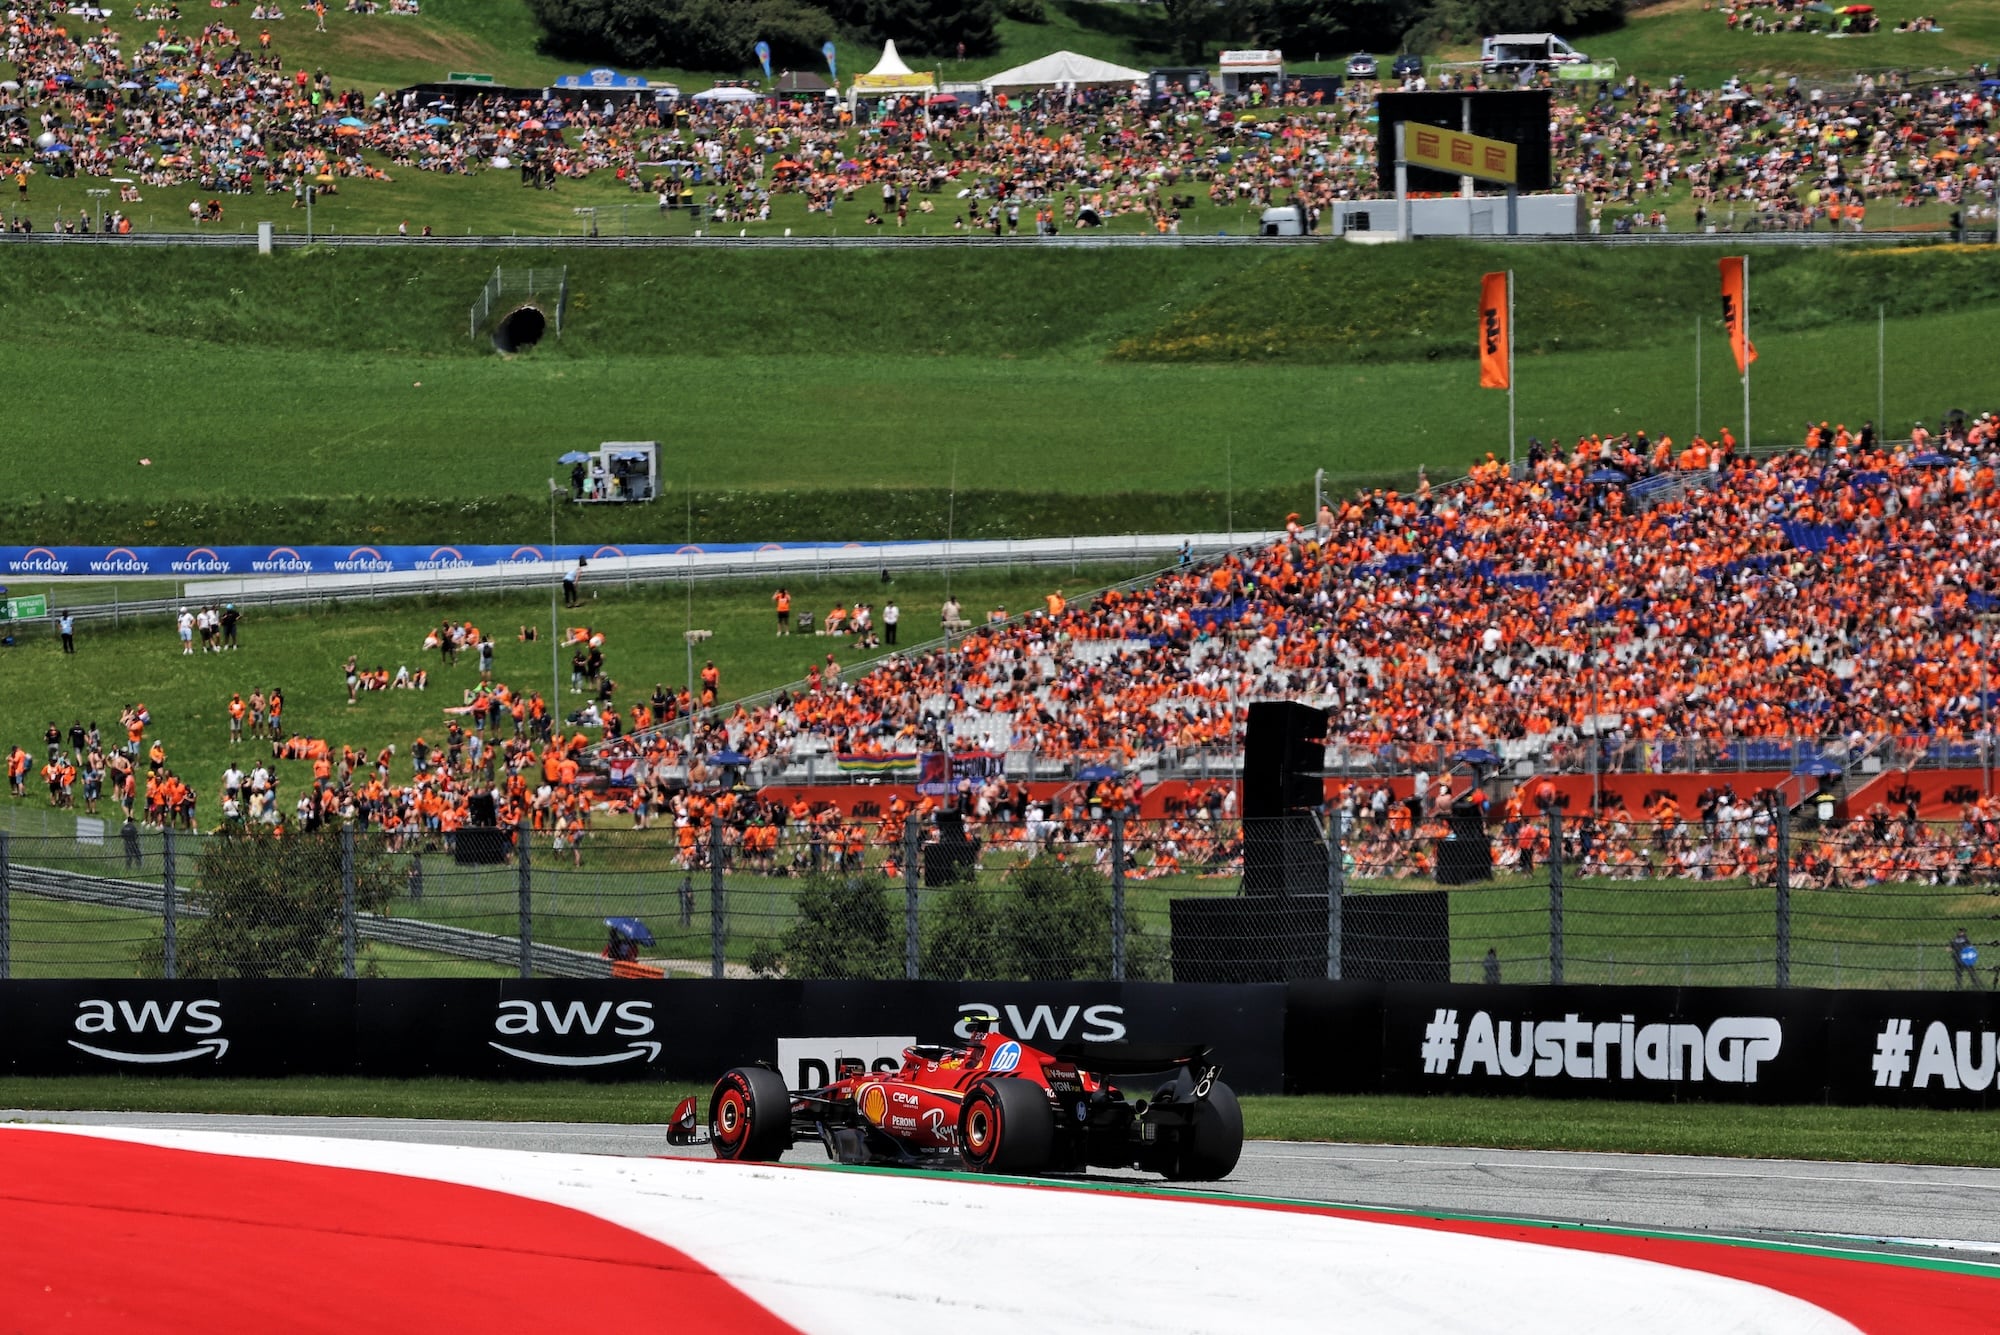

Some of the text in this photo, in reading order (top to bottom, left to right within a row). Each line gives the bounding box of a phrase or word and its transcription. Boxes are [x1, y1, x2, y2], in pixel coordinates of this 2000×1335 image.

[1485, 308, 1501, 355] KTM
[1887, 785, 1922, 803] KTM
[1943, 784, 1979, 803] KTM
[852, 801, 880, 817] KTM
[75, 1000, 222, 1034] aws
[496, 1000, 654, 1036] aws
[954, 1003, 1127, 1042] aws
[990, 1042, 1019, 1070] hp
[1872, 1019, 2000, 1091] #Au
[1050, 1069, 1076, 1079] V-Power
[1050, 1081, 1071, 1092] VGW
[892, 1115, 917, 1127] PERONI
